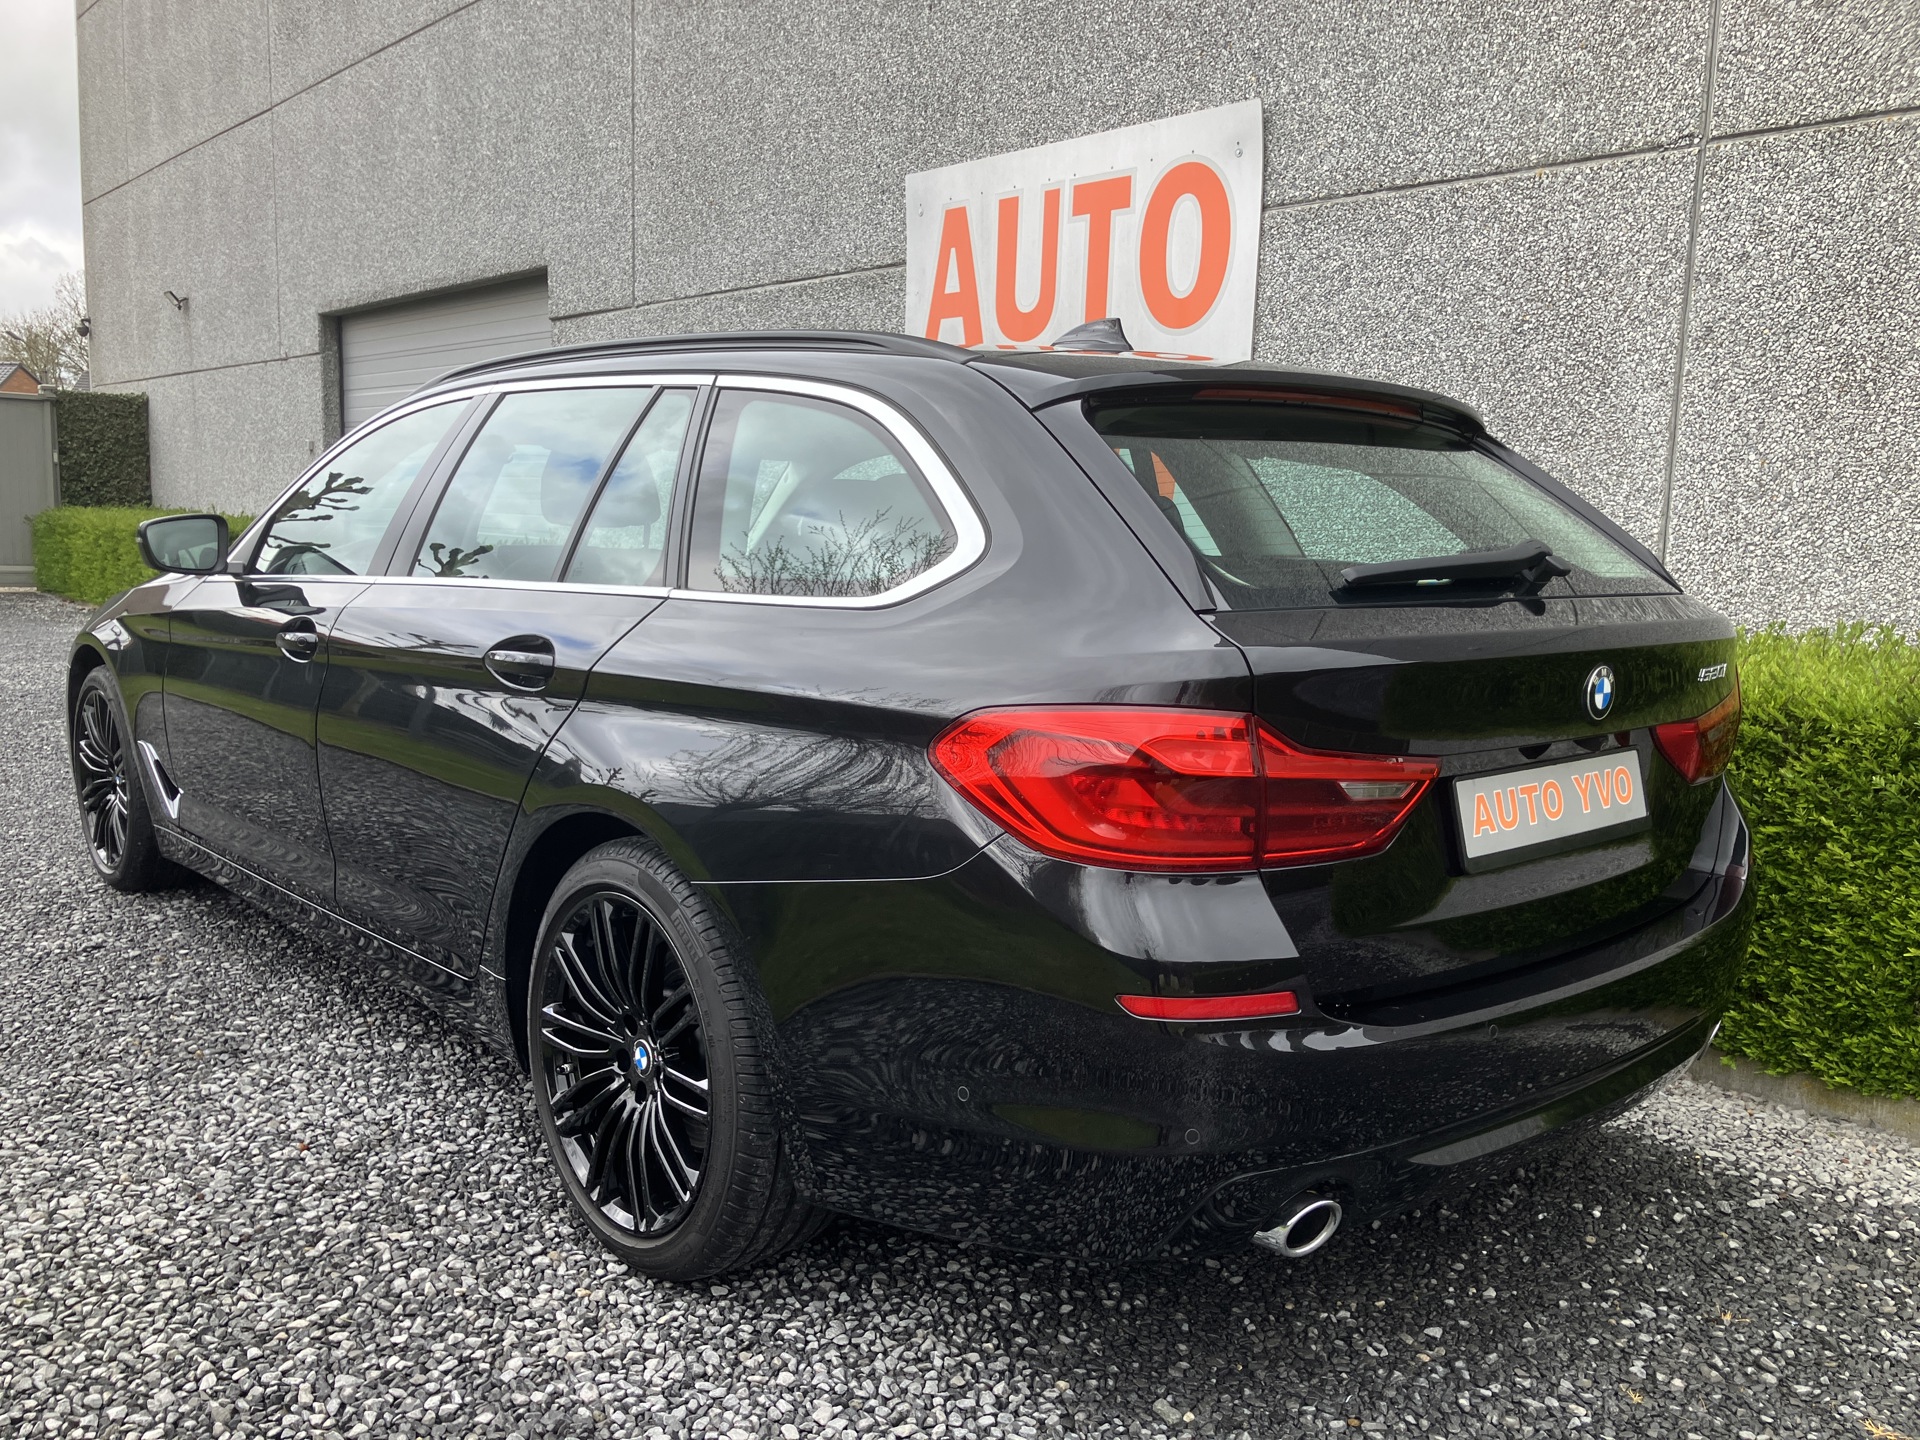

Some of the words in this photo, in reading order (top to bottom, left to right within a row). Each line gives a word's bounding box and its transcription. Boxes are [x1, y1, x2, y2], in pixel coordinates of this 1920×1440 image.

[925, 161, 1231, 346] AUTO
[1473, 779, 1564, 838] AUTO
[1571, 765, 1634, 814] YVO
